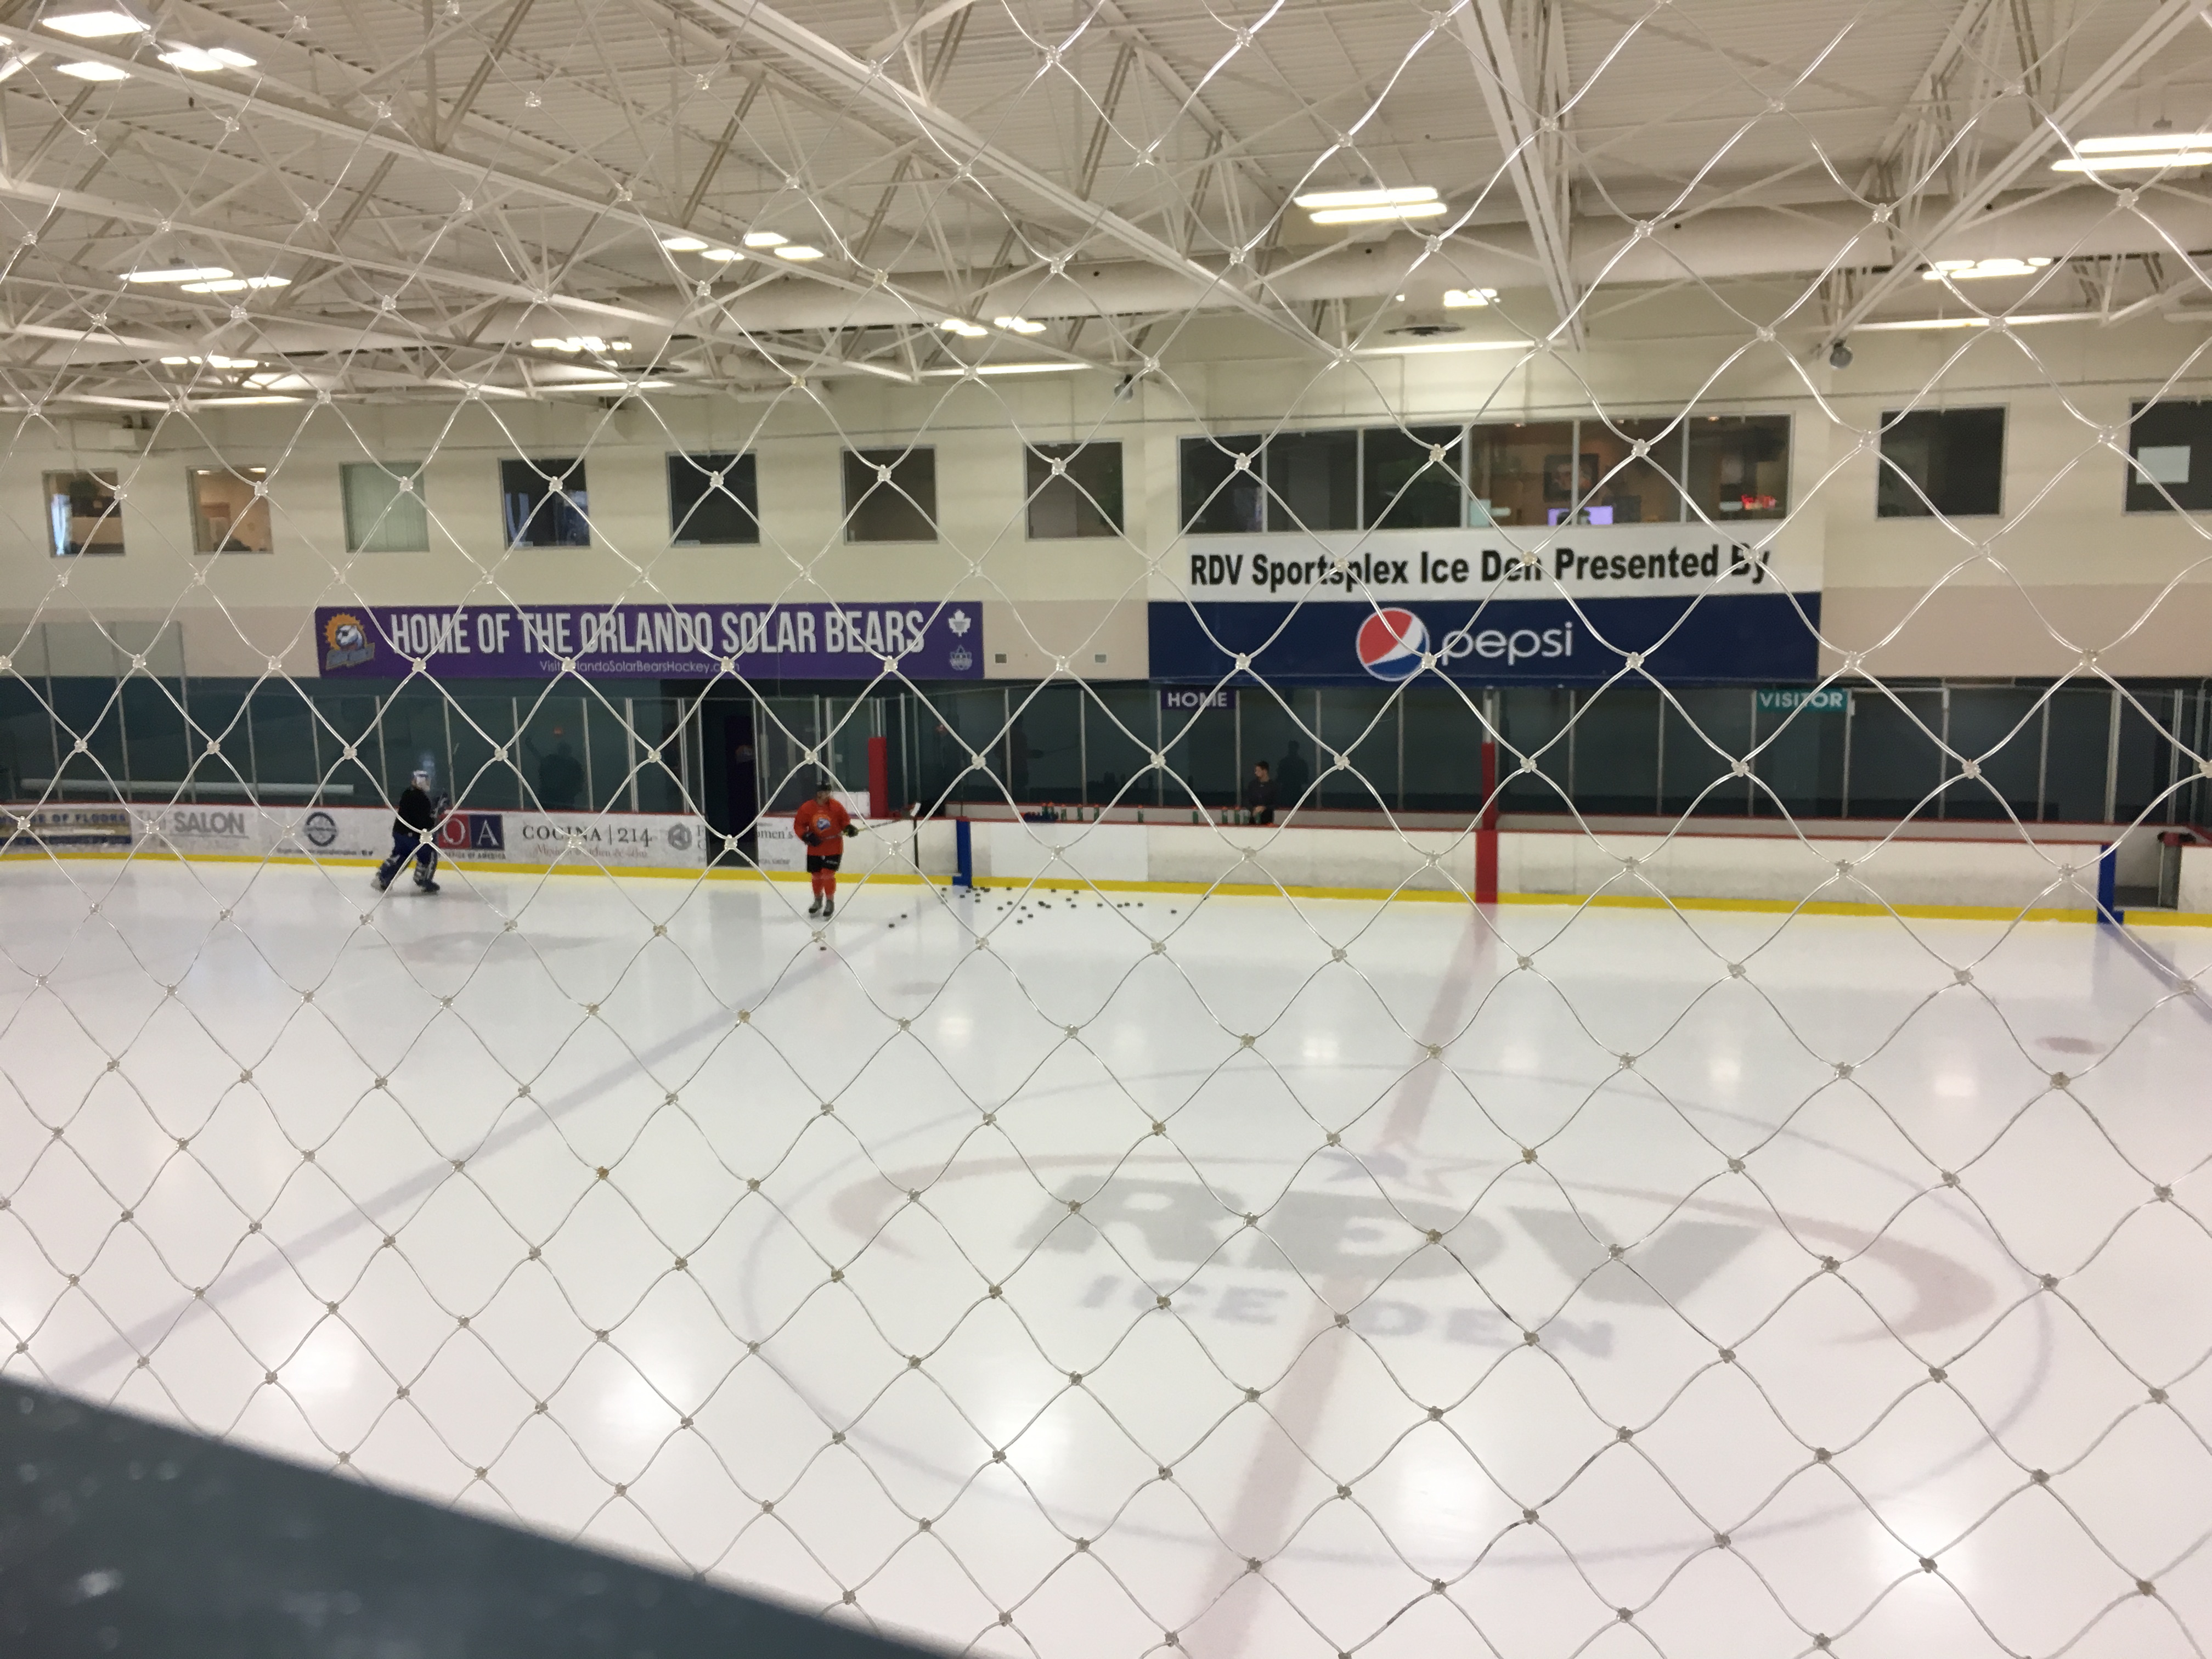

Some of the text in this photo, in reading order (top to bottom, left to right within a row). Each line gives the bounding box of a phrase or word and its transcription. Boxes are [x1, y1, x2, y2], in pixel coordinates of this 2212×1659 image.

[1190, 542, 1770, 592] RDV Sportsplex Ice Den Presented By
[390, 609, 925, 654] HOME OF THE ORLANDO SOLAR BEARS
[1442, 621, 1572, 667] pepsi
[540, 661, 740, 674] VisitlandoSolarBearsHockey.cm
[1167, 691, 1228, 708] HOME
[1759, 690, 1843, 708] VISITOR
[173, 811, 245, 834] SALON
[522, 825, 652, 847] COCINA 214
[1015, 1173, 1763, 1308] RDV
[1080, 1275, 1614, 1360] ICE DEN
